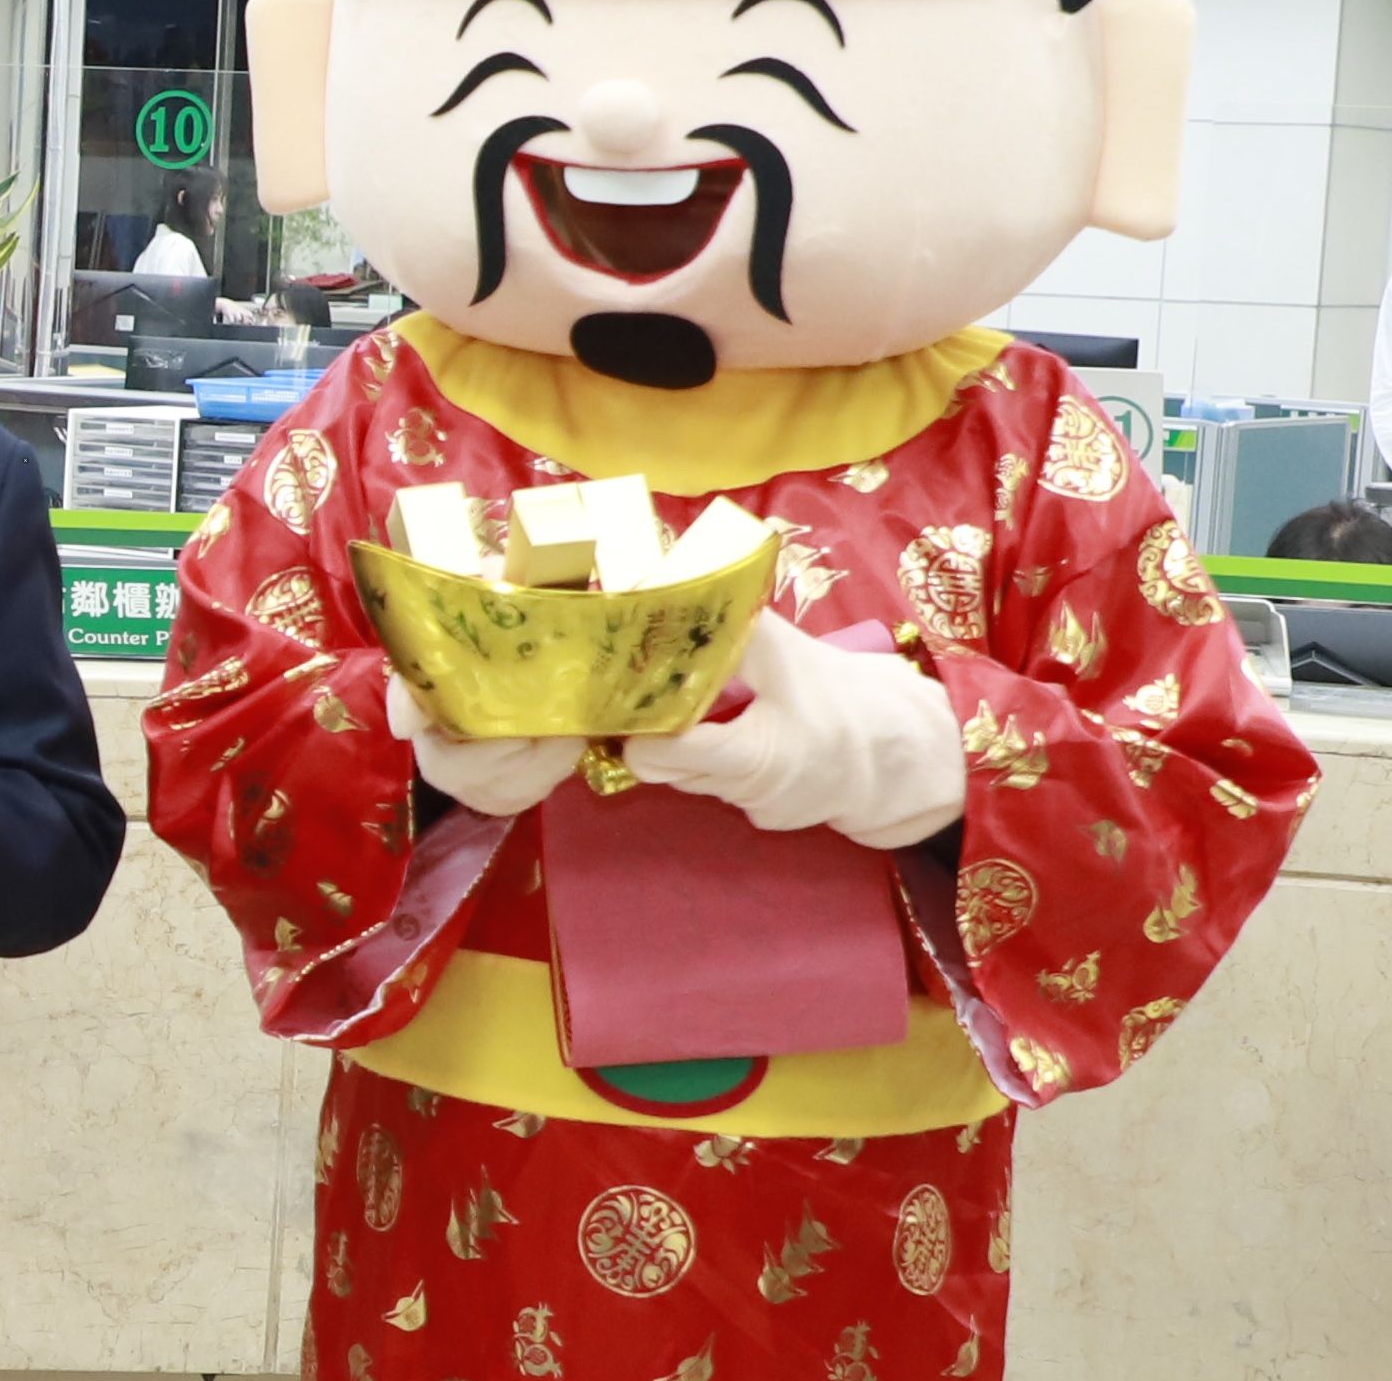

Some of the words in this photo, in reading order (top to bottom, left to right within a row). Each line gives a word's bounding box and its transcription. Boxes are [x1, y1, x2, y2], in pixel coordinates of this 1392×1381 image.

[149, 106, 204, 154] 10
[63, 580, 181, 619] 鄰櫃辦
[68, 627, 149, 646] Counter
